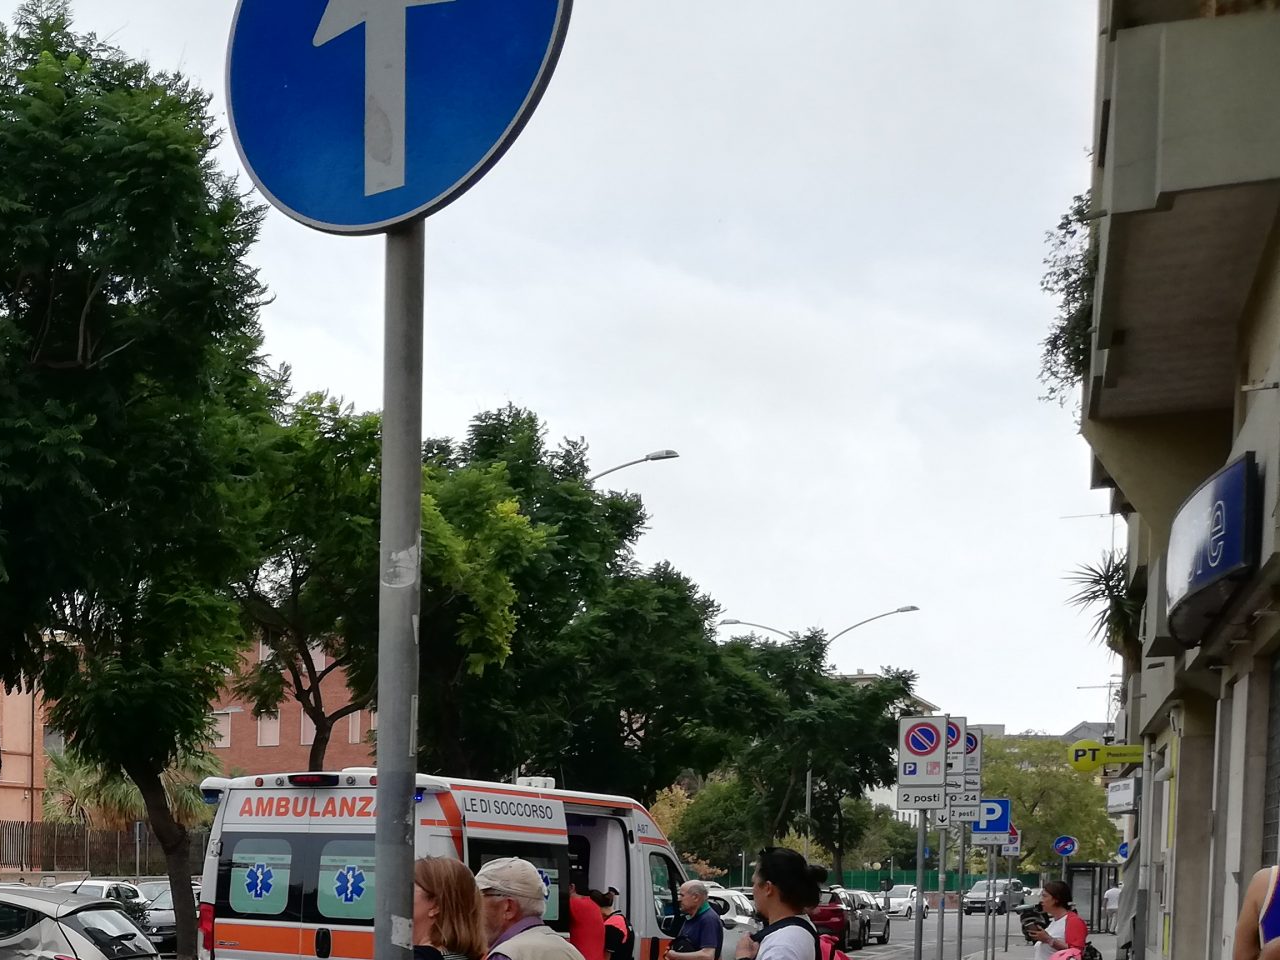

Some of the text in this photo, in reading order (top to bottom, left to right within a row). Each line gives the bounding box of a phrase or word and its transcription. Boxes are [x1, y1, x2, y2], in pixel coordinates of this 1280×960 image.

[1074, 749, 1100, 762] PT
[239, 796, 377, 817] AMBULANZ
[903, 793, 940, 804] 2 posti
[480, 799, 491, 813] DI
[494, 801, 553, 820] SOCCORSO
[958, 810, 976, 818] posti
[979, 802, 1002, 829] P
